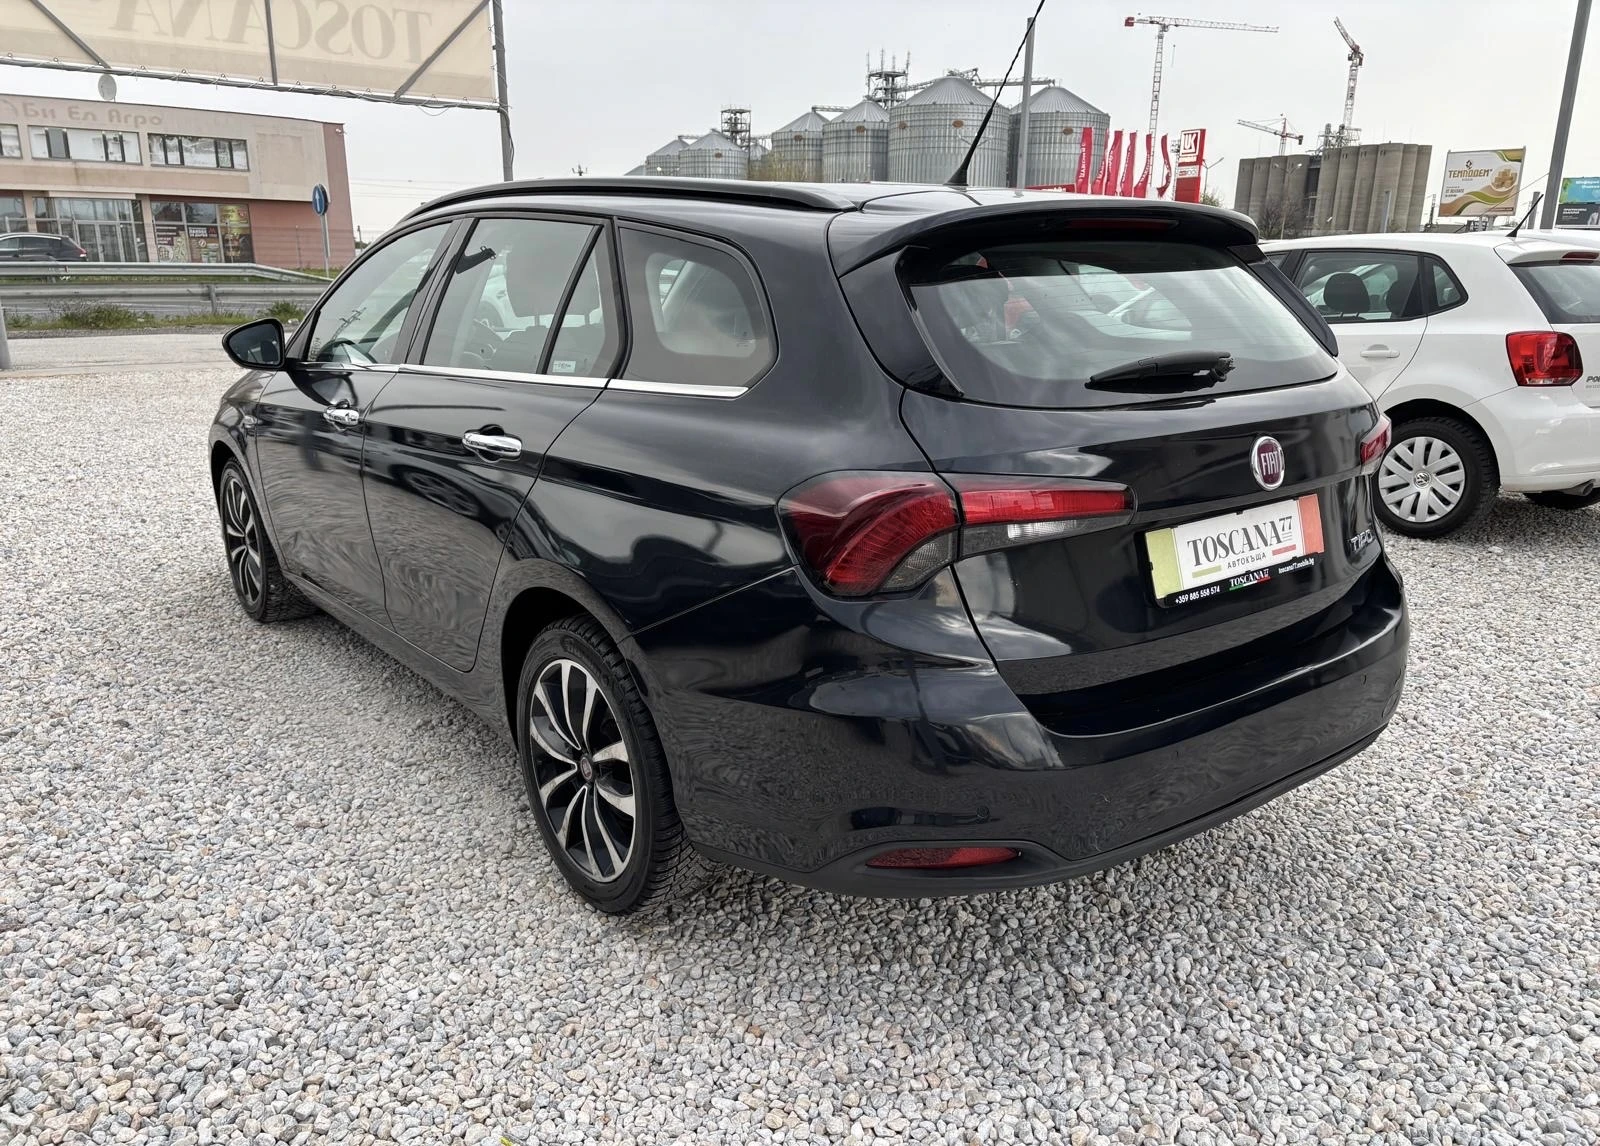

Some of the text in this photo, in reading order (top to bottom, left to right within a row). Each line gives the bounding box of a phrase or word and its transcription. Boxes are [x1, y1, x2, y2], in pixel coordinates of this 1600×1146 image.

[22, 102, 163, 128] Би Ел Агро
[1261, 451, 1279, 476] FIAT
[1227, 552, 1267, 569] АВТОКЪЩА
[1175, 593, 1189, 605] +359
[1210, 585, 1221, 596] 574
